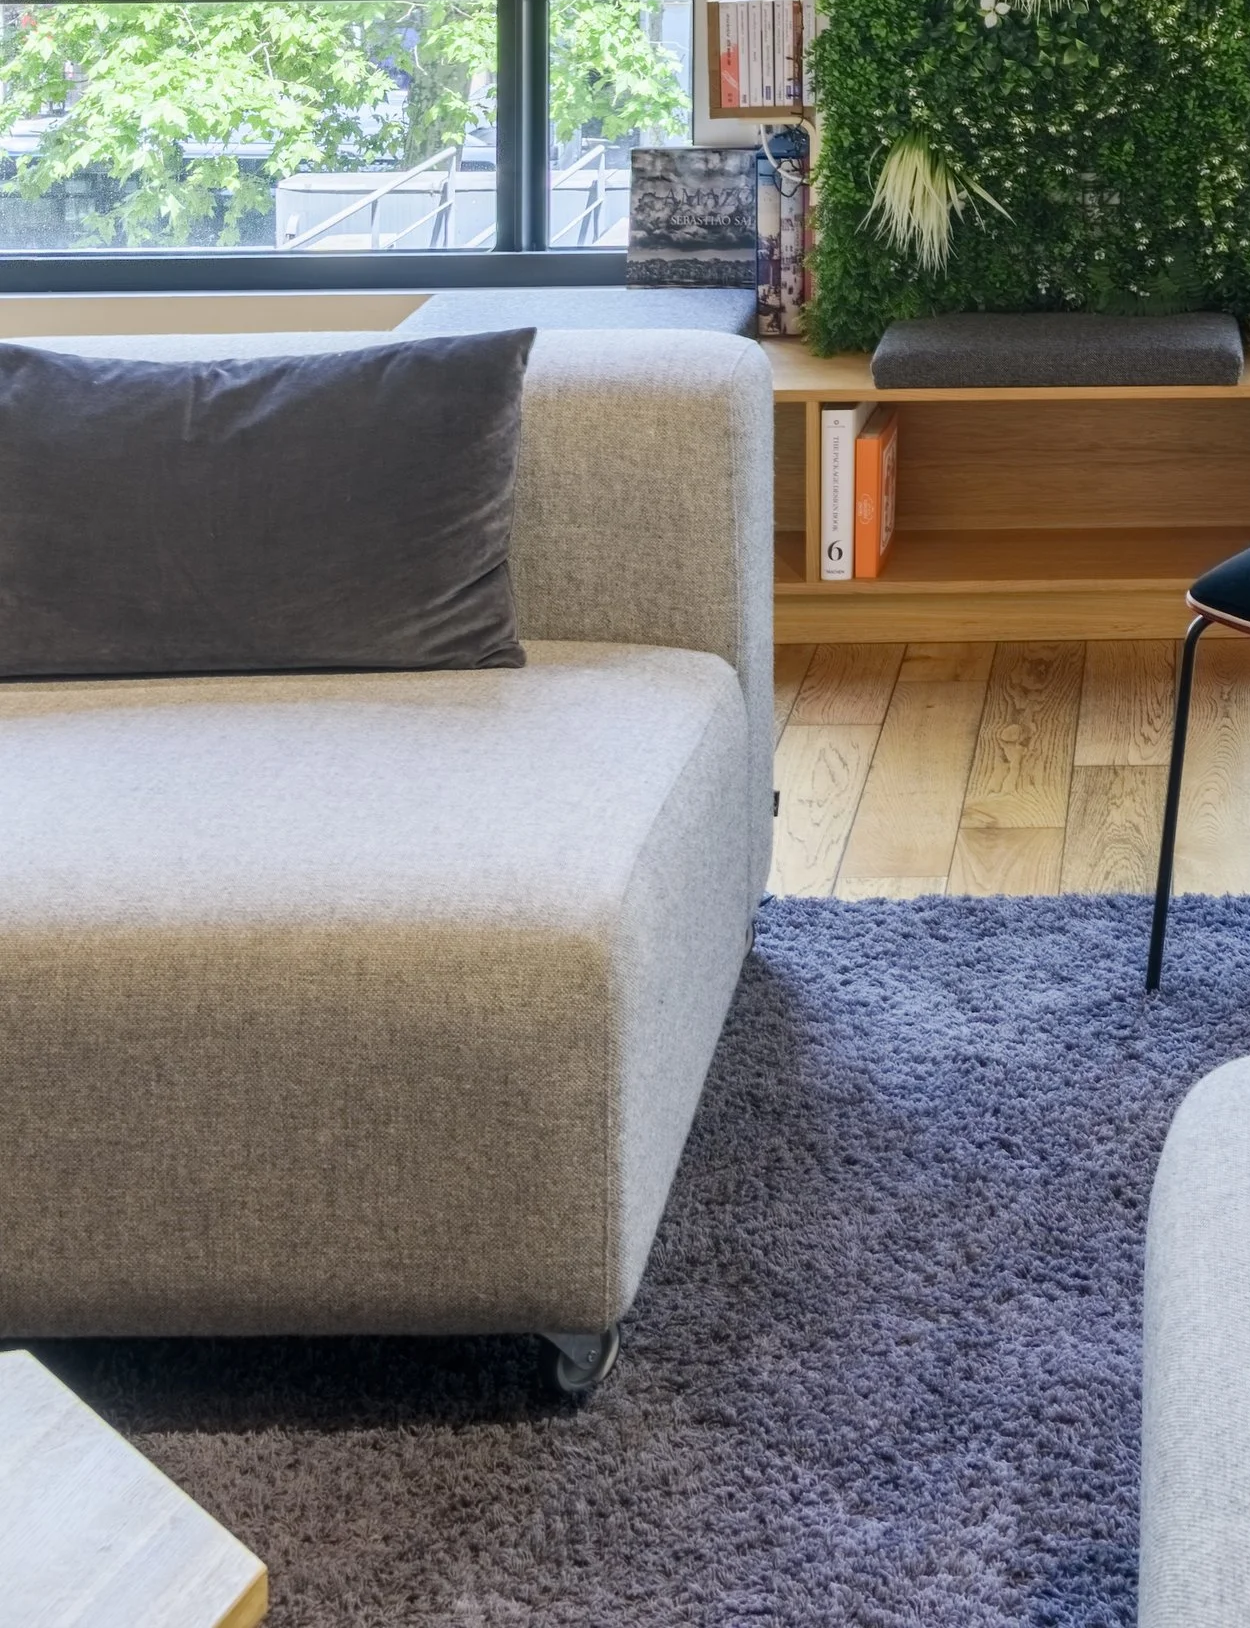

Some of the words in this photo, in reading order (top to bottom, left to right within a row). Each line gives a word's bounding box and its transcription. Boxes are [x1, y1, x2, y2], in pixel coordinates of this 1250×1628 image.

[663, 183, 755, 206] AMAZÔ
[832, 452, 840, 484] PACKAGE
[832, 486, 840, 512] DESIGN
[828, 539, 843, 561] 6
